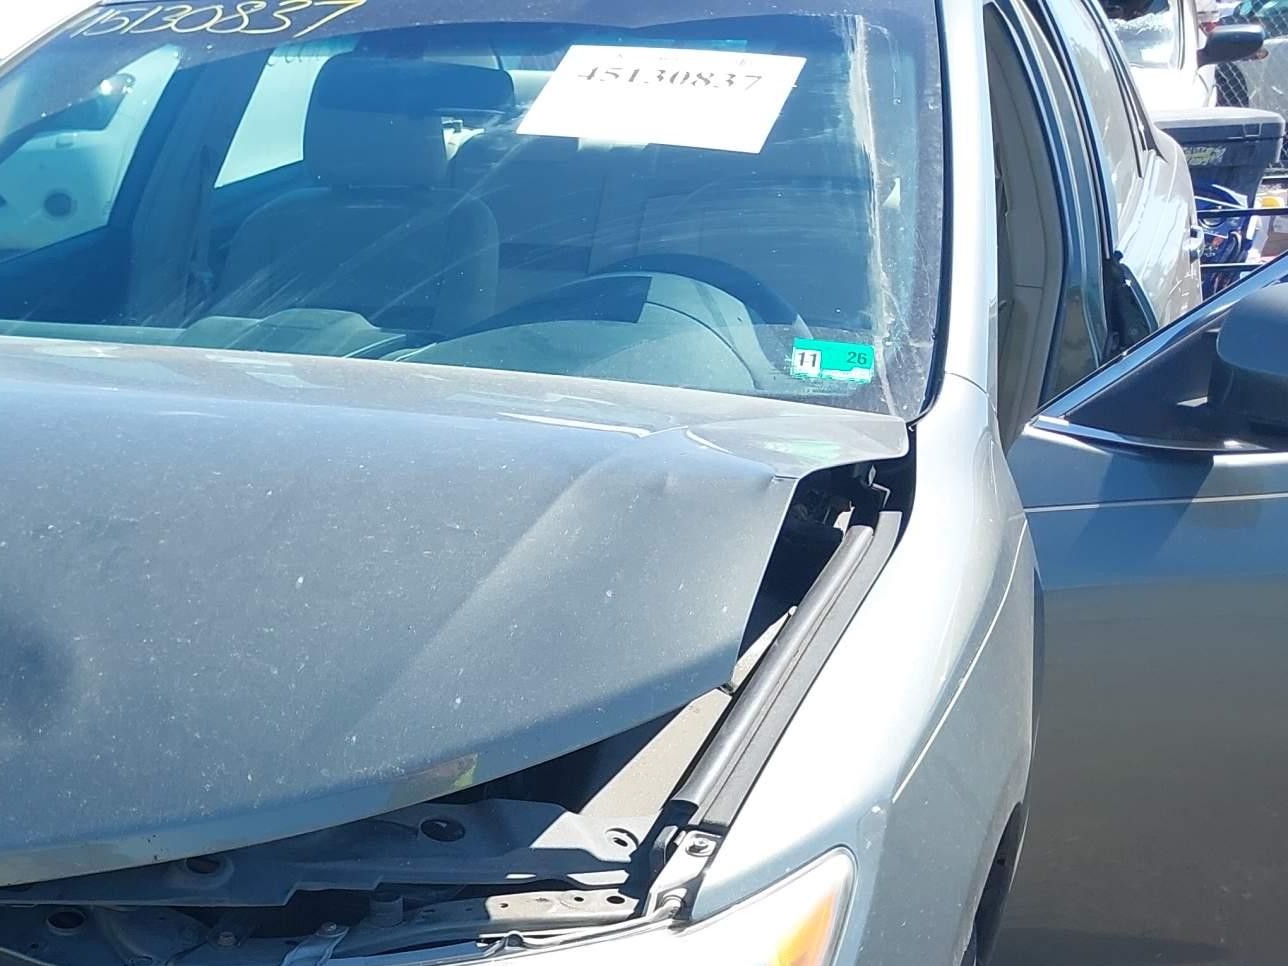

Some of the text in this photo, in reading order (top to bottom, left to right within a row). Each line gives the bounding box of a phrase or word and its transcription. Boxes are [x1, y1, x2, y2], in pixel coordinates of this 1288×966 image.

[577, 66, 763, 90] 45130837
[798, 350, 868, 368] 11 26
